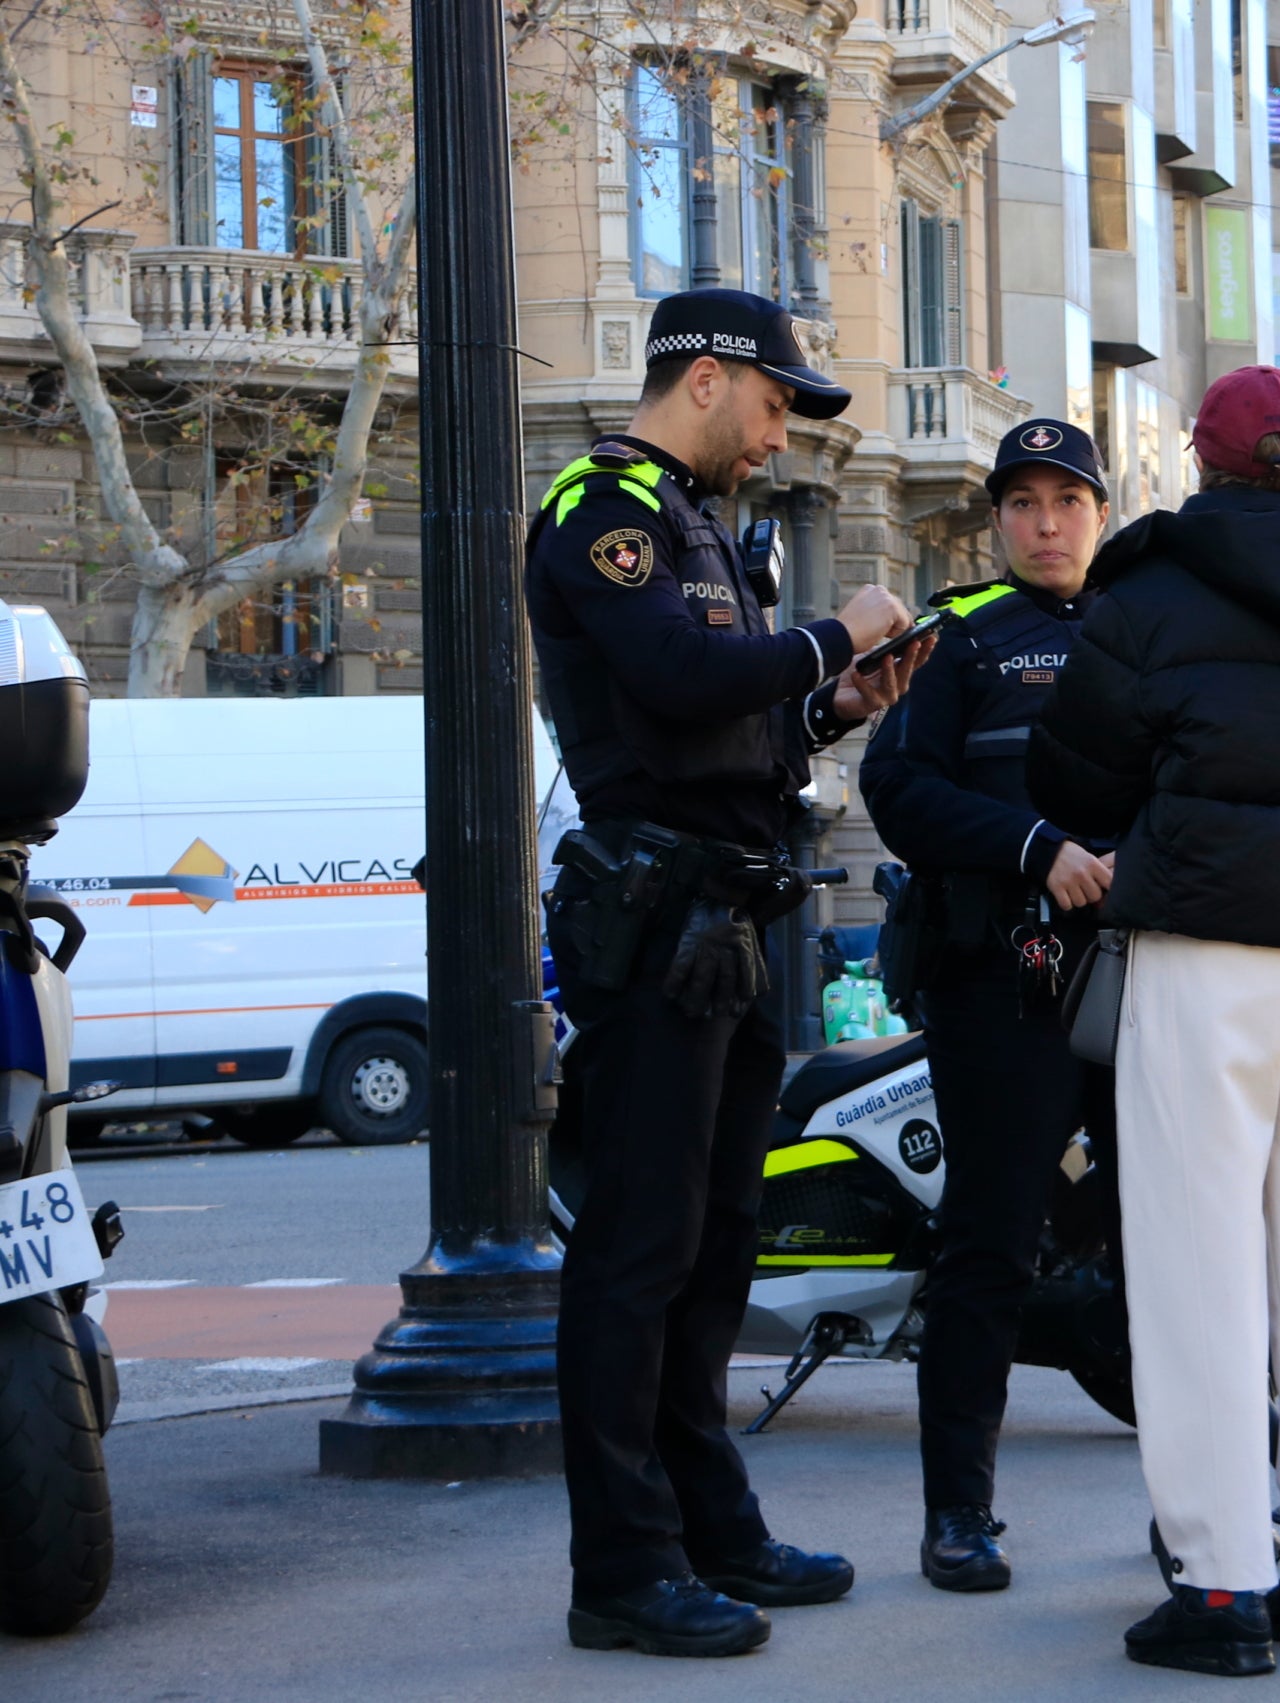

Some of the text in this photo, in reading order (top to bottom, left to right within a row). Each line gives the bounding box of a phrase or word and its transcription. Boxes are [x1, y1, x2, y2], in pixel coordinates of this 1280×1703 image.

[1217, 230, 1239, 319] seguros
[712, 333, 757, 351] POLICIA
[595, 531, 643, 552] BARCELONA
[641, 544, 650, 573] URBANA
[836, 1095, 887, 1127] Guàrdia
[903, 1129, 934, 1157] 112
